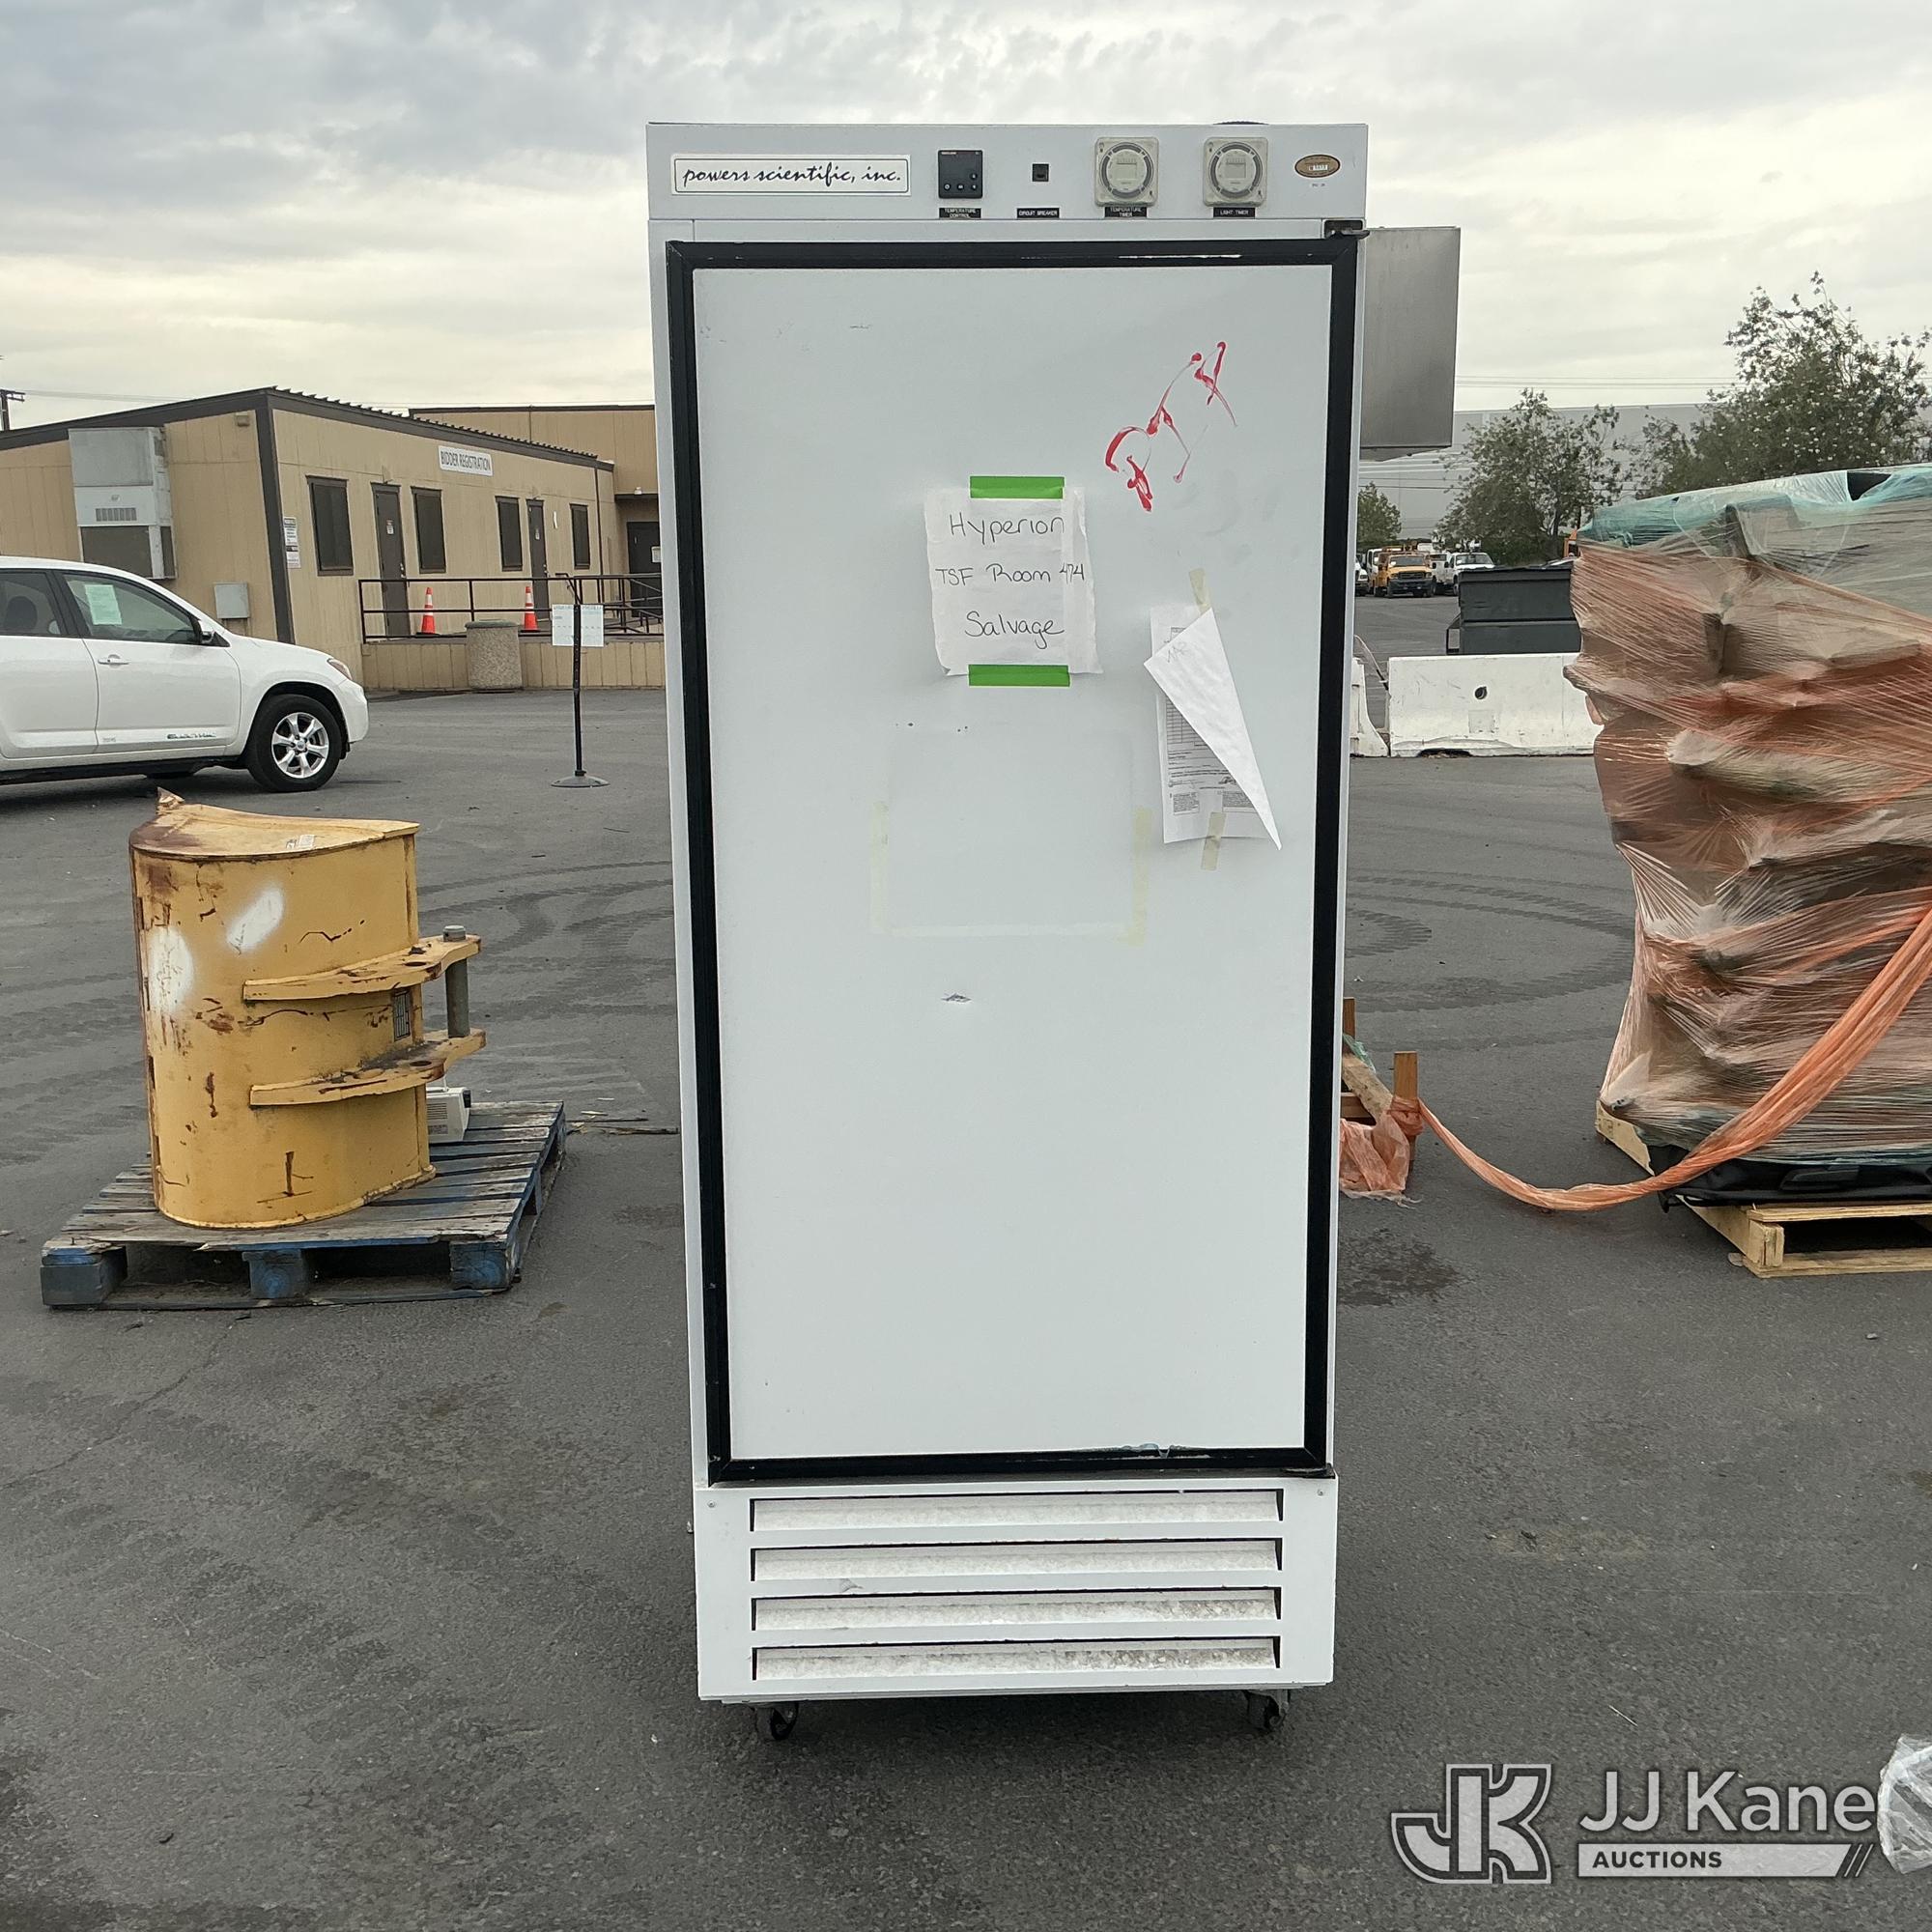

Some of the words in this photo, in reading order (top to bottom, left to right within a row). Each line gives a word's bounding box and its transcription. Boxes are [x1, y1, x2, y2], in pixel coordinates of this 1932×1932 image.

[682, 166, 750, 188] powers
[753, 161, 856, 187] scientific,
[861, 165, 901, 183] inc.
[440, 450, 459, 467] BIDDER
[459, 454, 491, 471] REGISTRATION
[950, 512, 1065, 545] Hyperion
[935, 567, 974, 585] TSF
[985, 562, 1051, 582] Room
[964, 611, 1065, 650] Salvage
